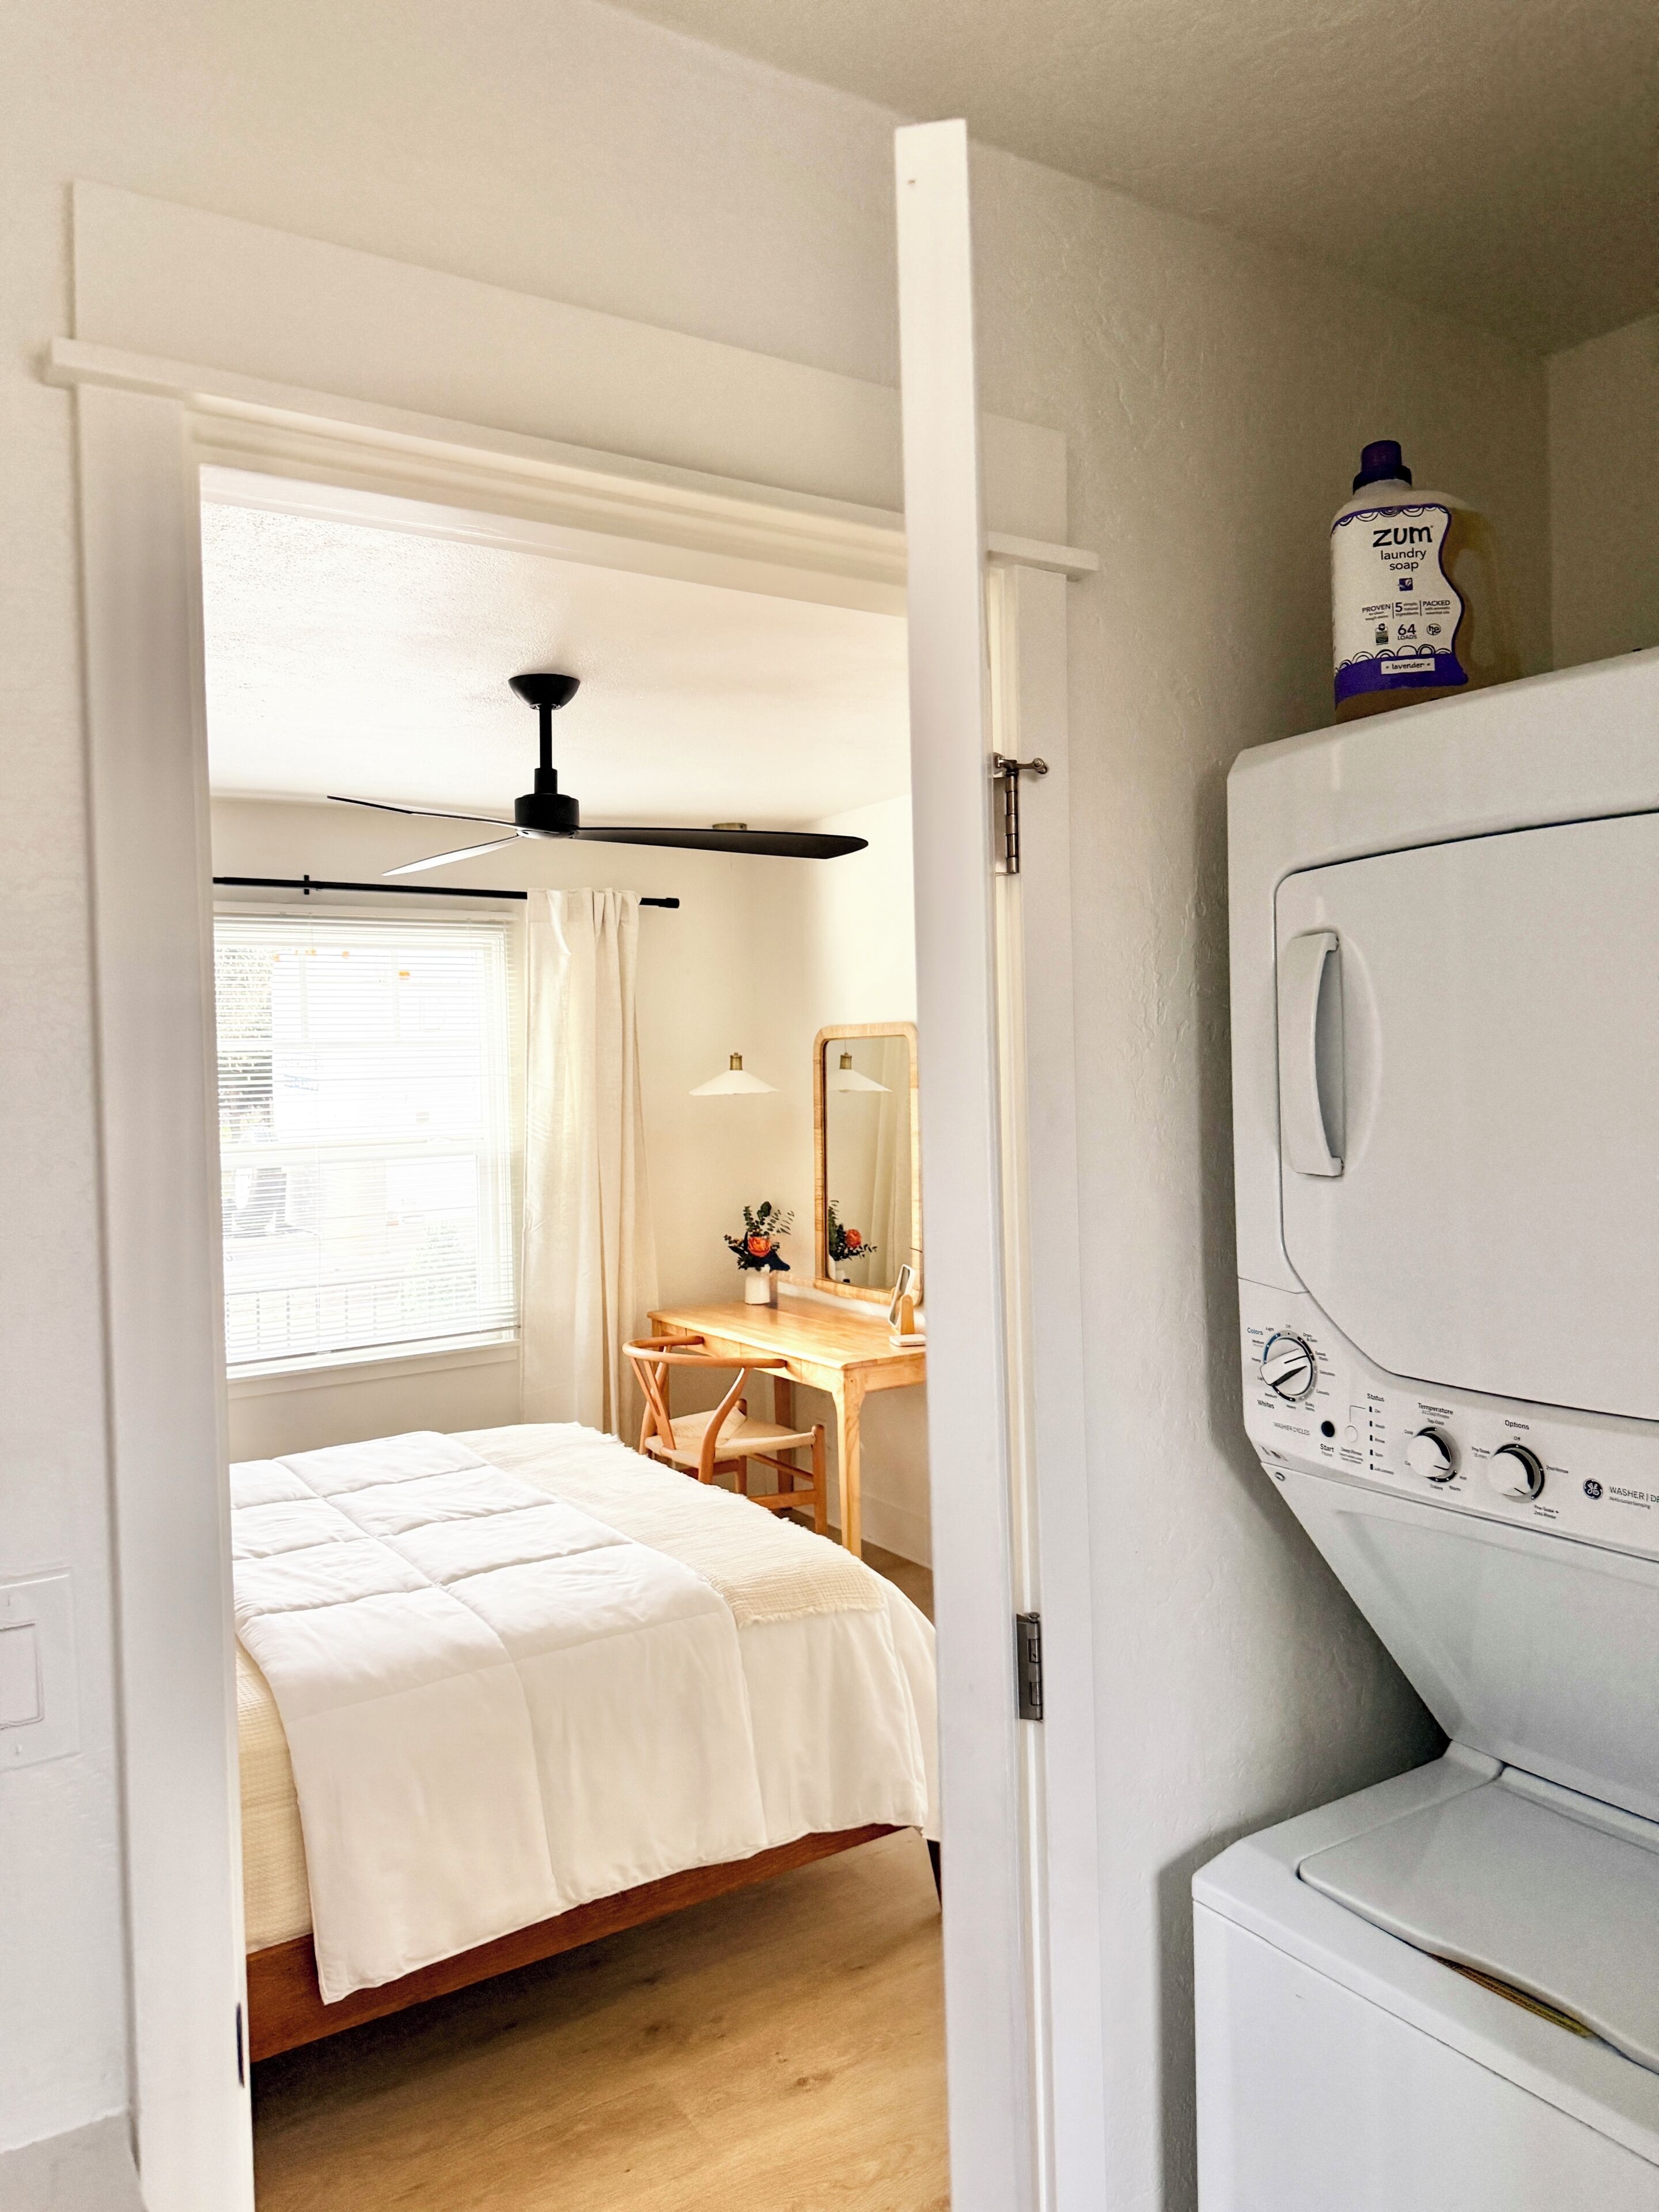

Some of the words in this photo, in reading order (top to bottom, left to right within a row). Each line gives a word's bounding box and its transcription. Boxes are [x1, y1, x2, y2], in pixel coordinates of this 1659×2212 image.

[1381, 548, 1426, 560] laundry
[1389, 562, 1419, 571] soap
[1362, 604, 1391, 613] PROVEN
[1395, 602, 1403, 612] 5
[1398, 624, 1416, 635] 64
[1247, 1327, 1263, 1335] Colors
[1367, 1393, 1385, 1402] Status
[1257, 1400, 1274, 1409] Whites
[1418, 1402, 1453, 1415] Temperature
[1505, 1420, 1529, 1430] Options
[1320, 1444, 1334, 1453] Start
[1610, 1486, 1645, 1499] WASHER
